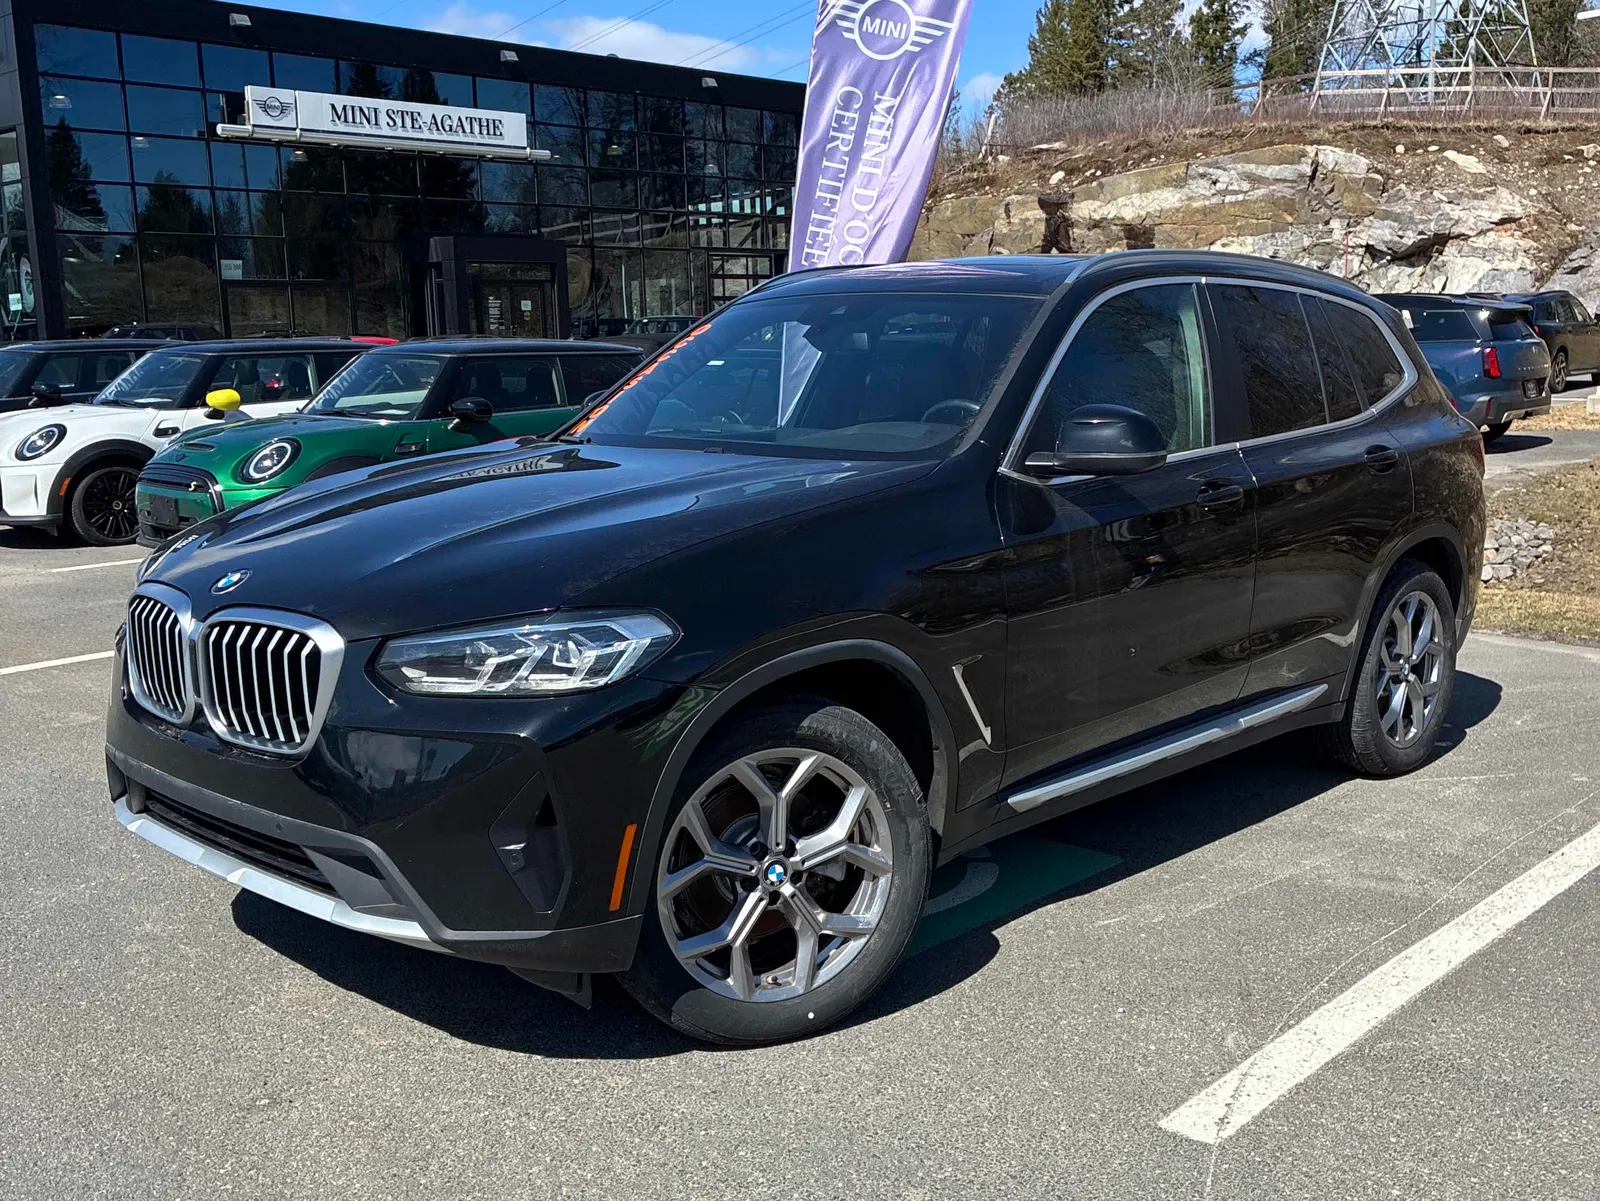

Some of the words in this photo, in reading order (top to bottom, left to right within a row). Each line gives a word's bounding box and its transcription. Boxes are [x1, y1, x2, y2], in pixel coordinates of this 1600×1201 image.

[862, 16, 907, 39] MINI
[329, 103, 380, 127] MINI
[386, 108, 503, 137] STE-AGATHE
[856, 91, 903, 178] MINI
[188, 481, 198, 492] S
